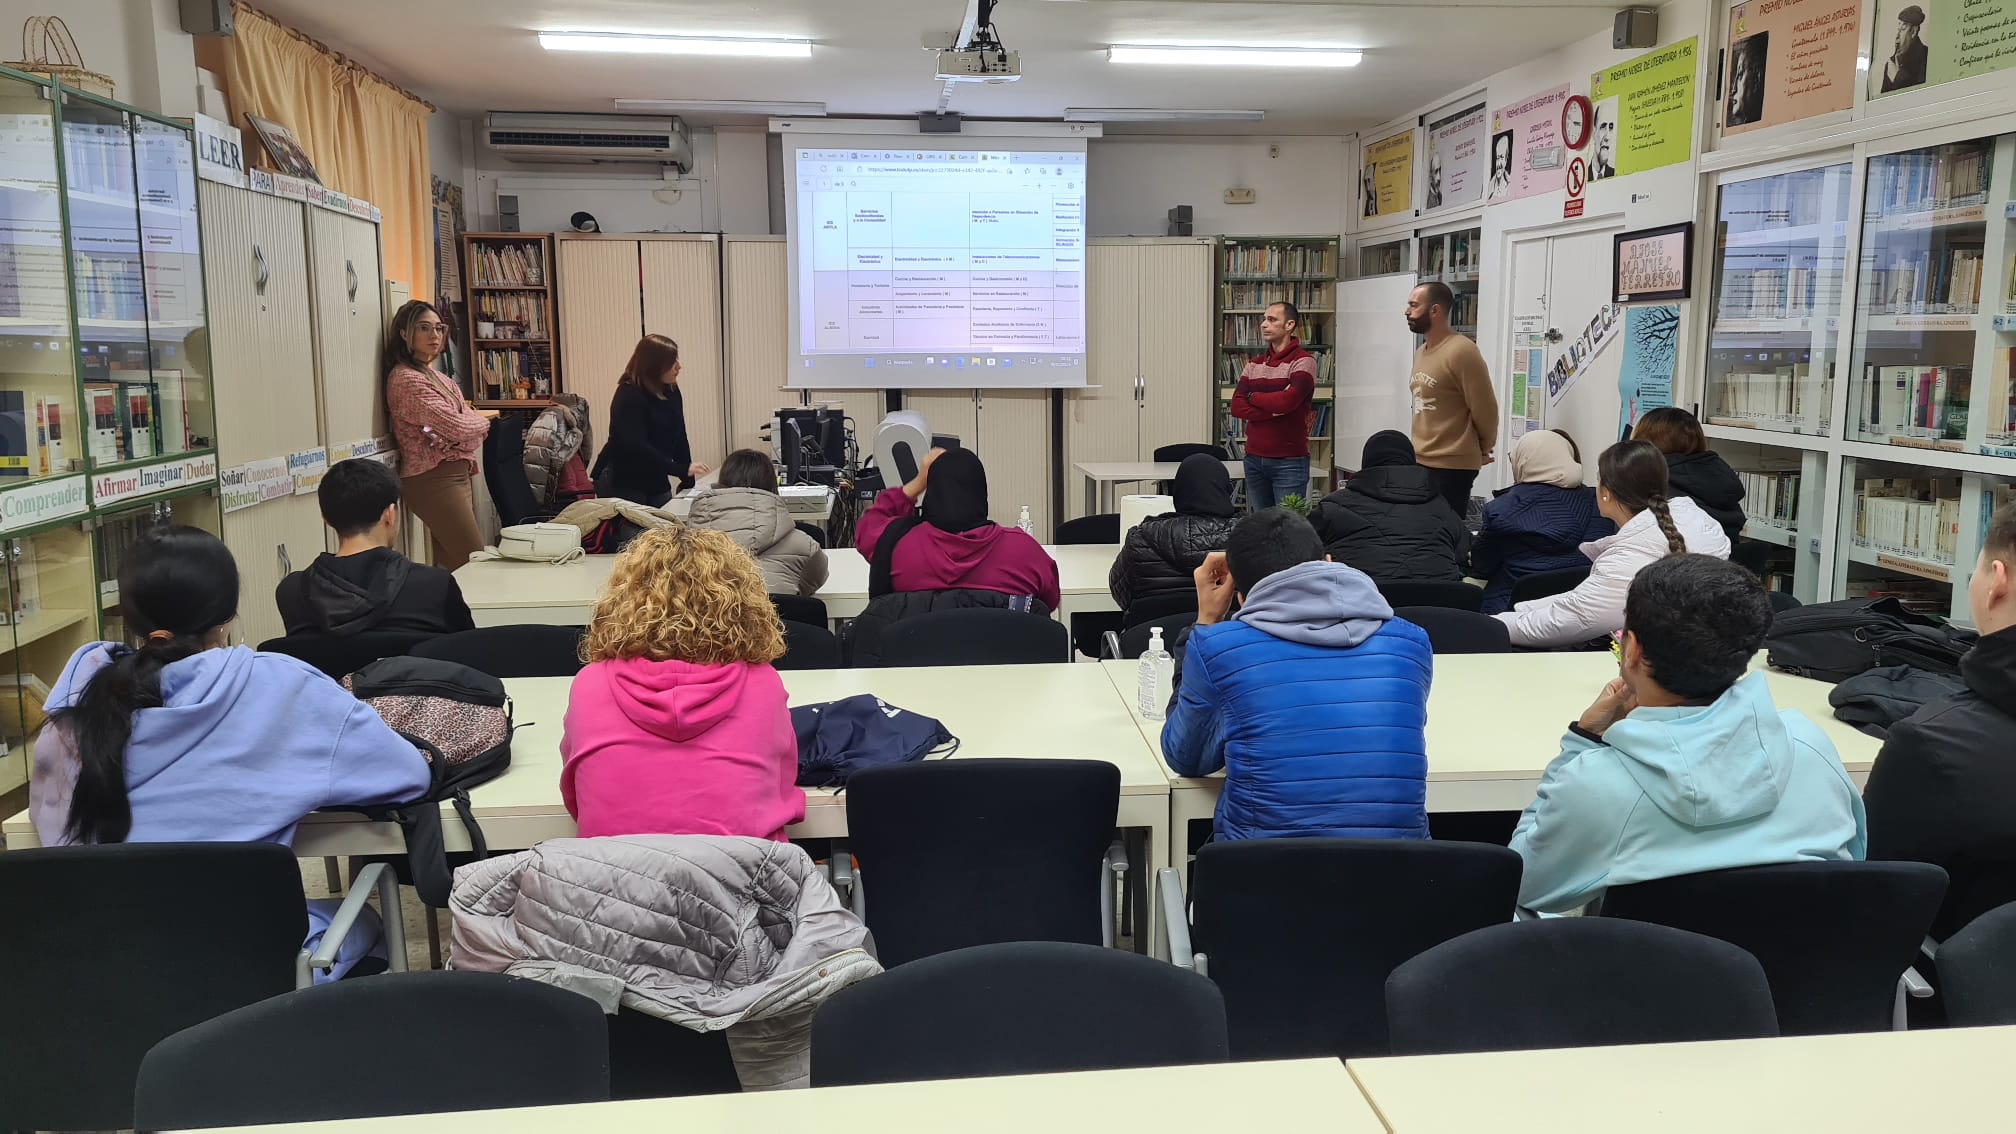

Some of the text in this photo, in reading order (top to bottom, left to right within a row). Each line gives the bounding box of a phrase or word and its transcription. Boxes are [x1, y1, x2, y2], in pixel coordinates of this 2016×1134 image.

[199, 131, 243, 172] LEER
[251, 171, 271, 190] PARA
[1410, 371, 1438, 389] ACOSTE
[95, 459, 216, 499] Afirmar Imaginar Dudar
[221, 470, 244, 488] Soñar
[290, 450, 325, 470] Refugiarnos
[3, 485, 86, 518] Comprender
[224, 471, 324, 510] Disfrutar Combatir Compart
